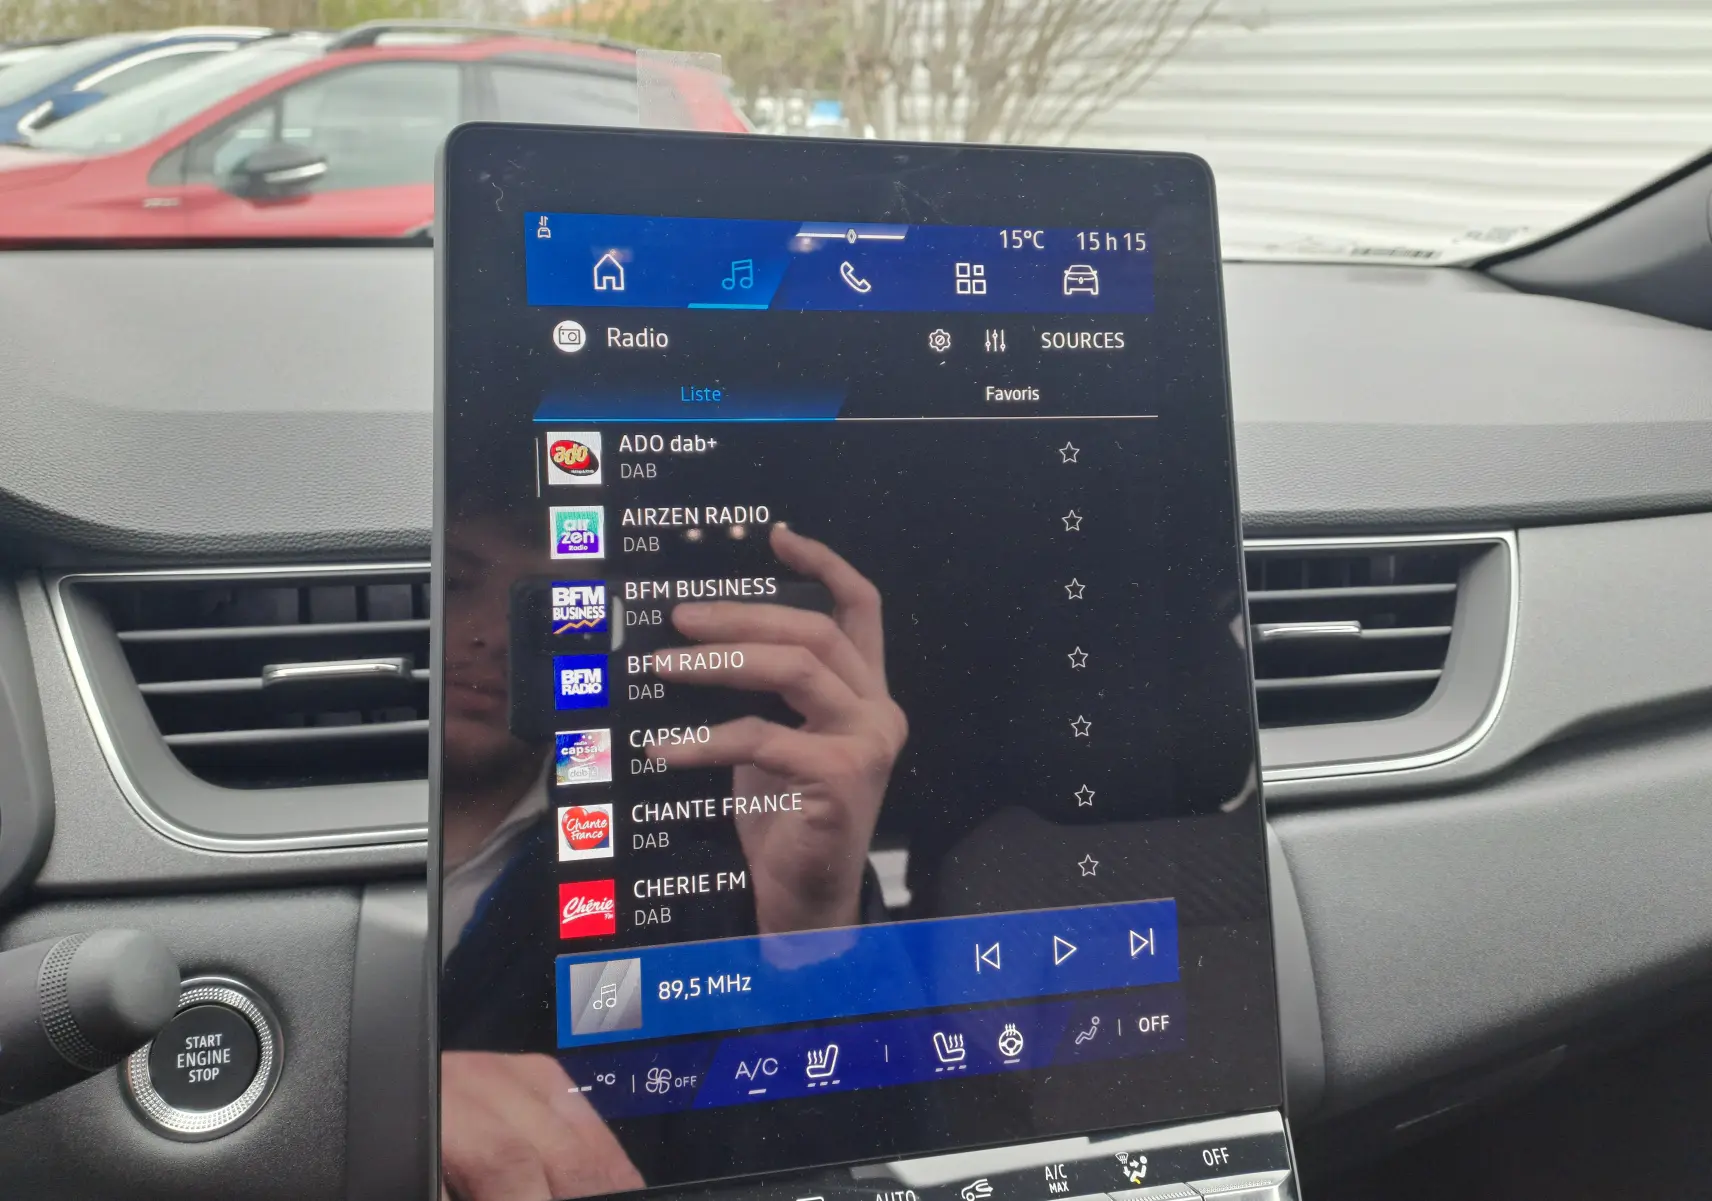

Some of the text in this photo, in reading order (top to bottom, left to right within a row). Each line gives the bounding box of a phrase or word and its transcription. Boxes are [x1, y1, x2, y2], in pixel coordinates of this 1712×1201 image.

[999, 229, 1045, 249] 15°C
[1076, 231, 1146, 251] 15 h 15
[606, 327, 669, 350] Radio
[1041, 331, 1125, 350] SOURCES
[680, 385, 722, 403] Liste
[985, 385, 1040, 403] Favoris
[619, 434, 718, 453] ADO dab+
[553, 443, 588, 465] ado
[620, 463, 657, 479] DAB
[622, 505, 770, 526] AIRZEN RADIO
[560, 531, 595, 544] zen
[623, 536, 660, 552] DAB
[552, 586, 605, 606] BFM
[625, 577, 777, 600] BFM BUSINESS
[552, 605, 606, 621] BUSINESS
[626, 610, 663, 626] DAB
[627, 651, 745, 674] BFM RADIO
[561, 668, 602, 685] BFM
[561, 682, 602, 696] RADIO
[628, 684, 665, 700] DAB
[629, 726, 711, 747] CAPSAO
[630, 758, 668, 775] DAB
[631, 793, 803, 823] CHANTE FRANCE
[566, 818, 608, 832] Chante
[571, 829, 604, 840] France
[633, 832, 670, 850] DAB
[633, 871, 746, 898] CHERIE FM
[634, 907, 672, 926] DAB
[658, 973, 752, 1000] 89,5 MHz
[1138, 1014, 1170, 1033] OFF
[185, 1033, 222, 1050] START
[177, 1047, 231, 1069] ENGINE
[188, 1067, 220, 1083] STOP
[735, 1057, 779, 1081] A/C
[674, 1075, 697, 1088] OFF
[1202, 1147, 1230, 1167] OFF
[1045, 1163, 1068, 1181] A/C
[1048, 1181, 1070, 1193] MAX
